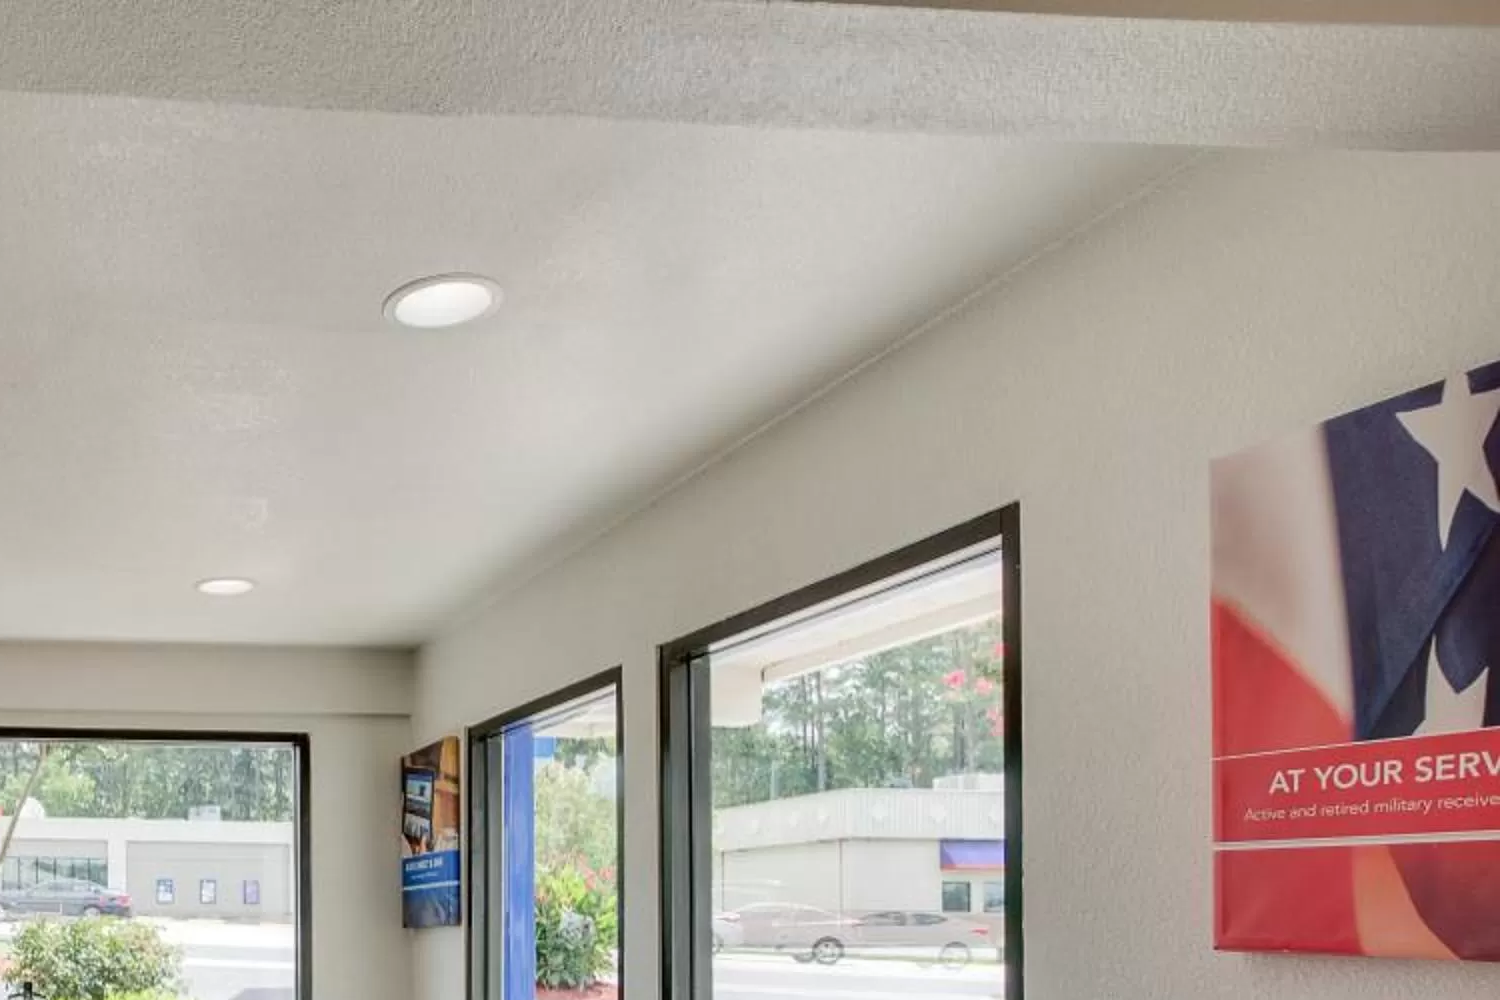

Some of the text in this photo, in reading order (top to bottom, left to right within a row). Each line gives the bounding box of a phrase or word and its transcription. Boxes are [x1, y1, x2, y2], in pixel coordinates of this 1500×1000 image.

[1269, 769, 1306, 795] AT
[1313, 760, 1403, 788] YOUR
[1244, 807, 1286, 821] Active
[1290, 804, 1317, 819] and
[1321, 799, 1370, 817] retired
[1374, 798, 1433, 816] military
